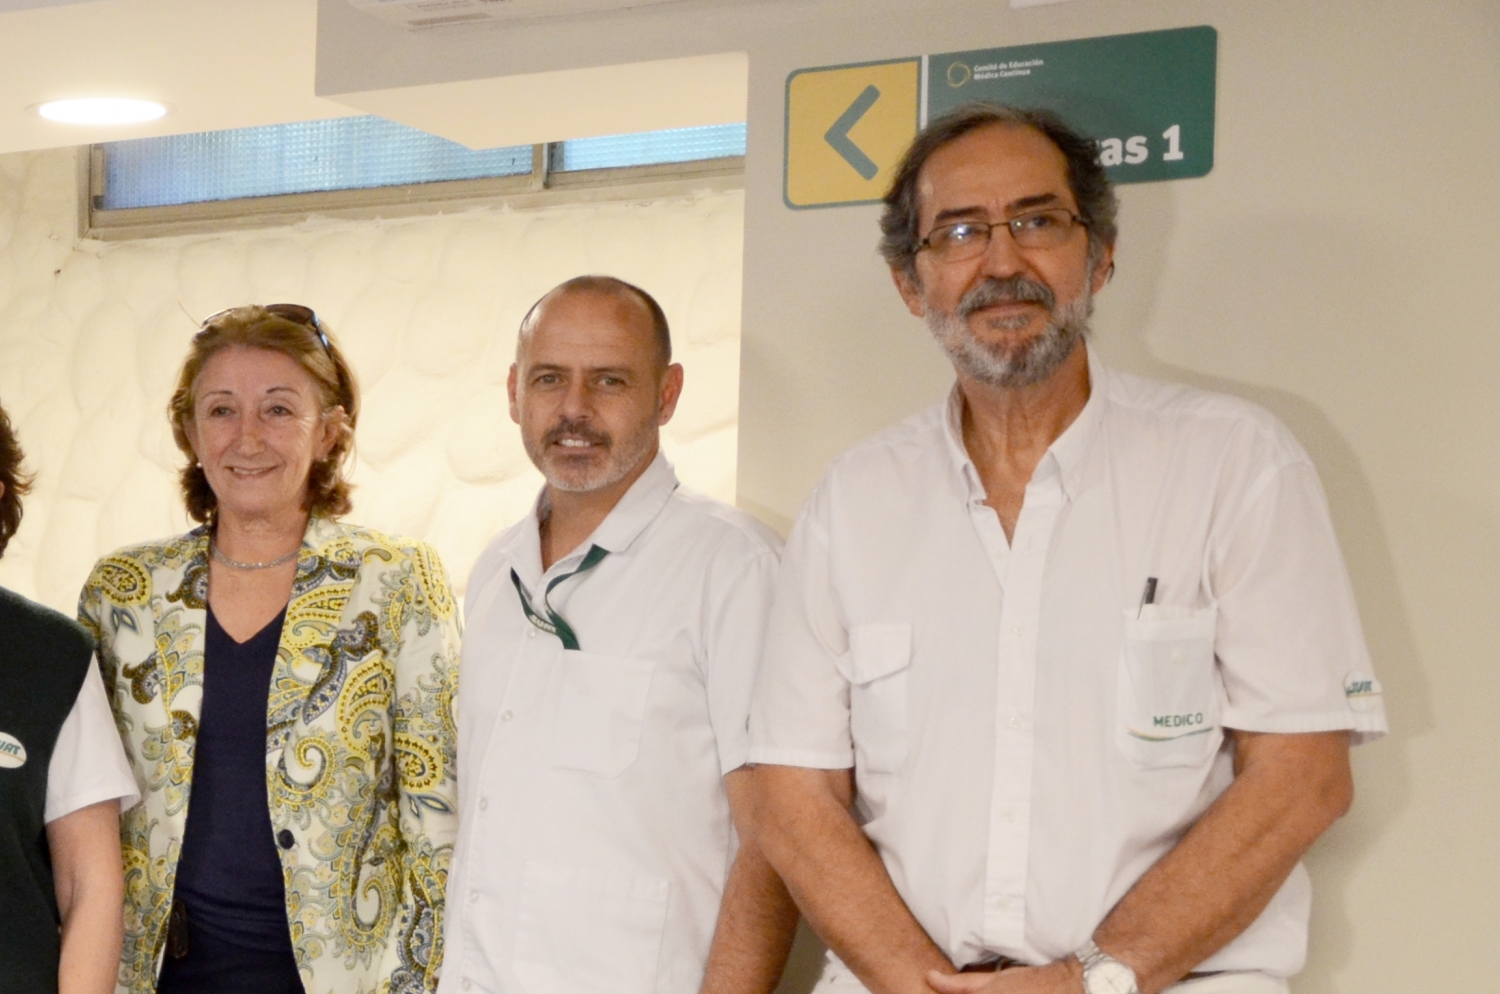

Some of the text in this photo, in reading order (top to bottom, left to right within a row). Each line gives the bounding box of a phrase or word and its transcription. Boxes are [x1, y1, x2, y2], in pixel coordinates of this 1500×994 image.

[1094, 124, 1184, 167] as 1
[1153, 712, 1204, 728] MEDICO
